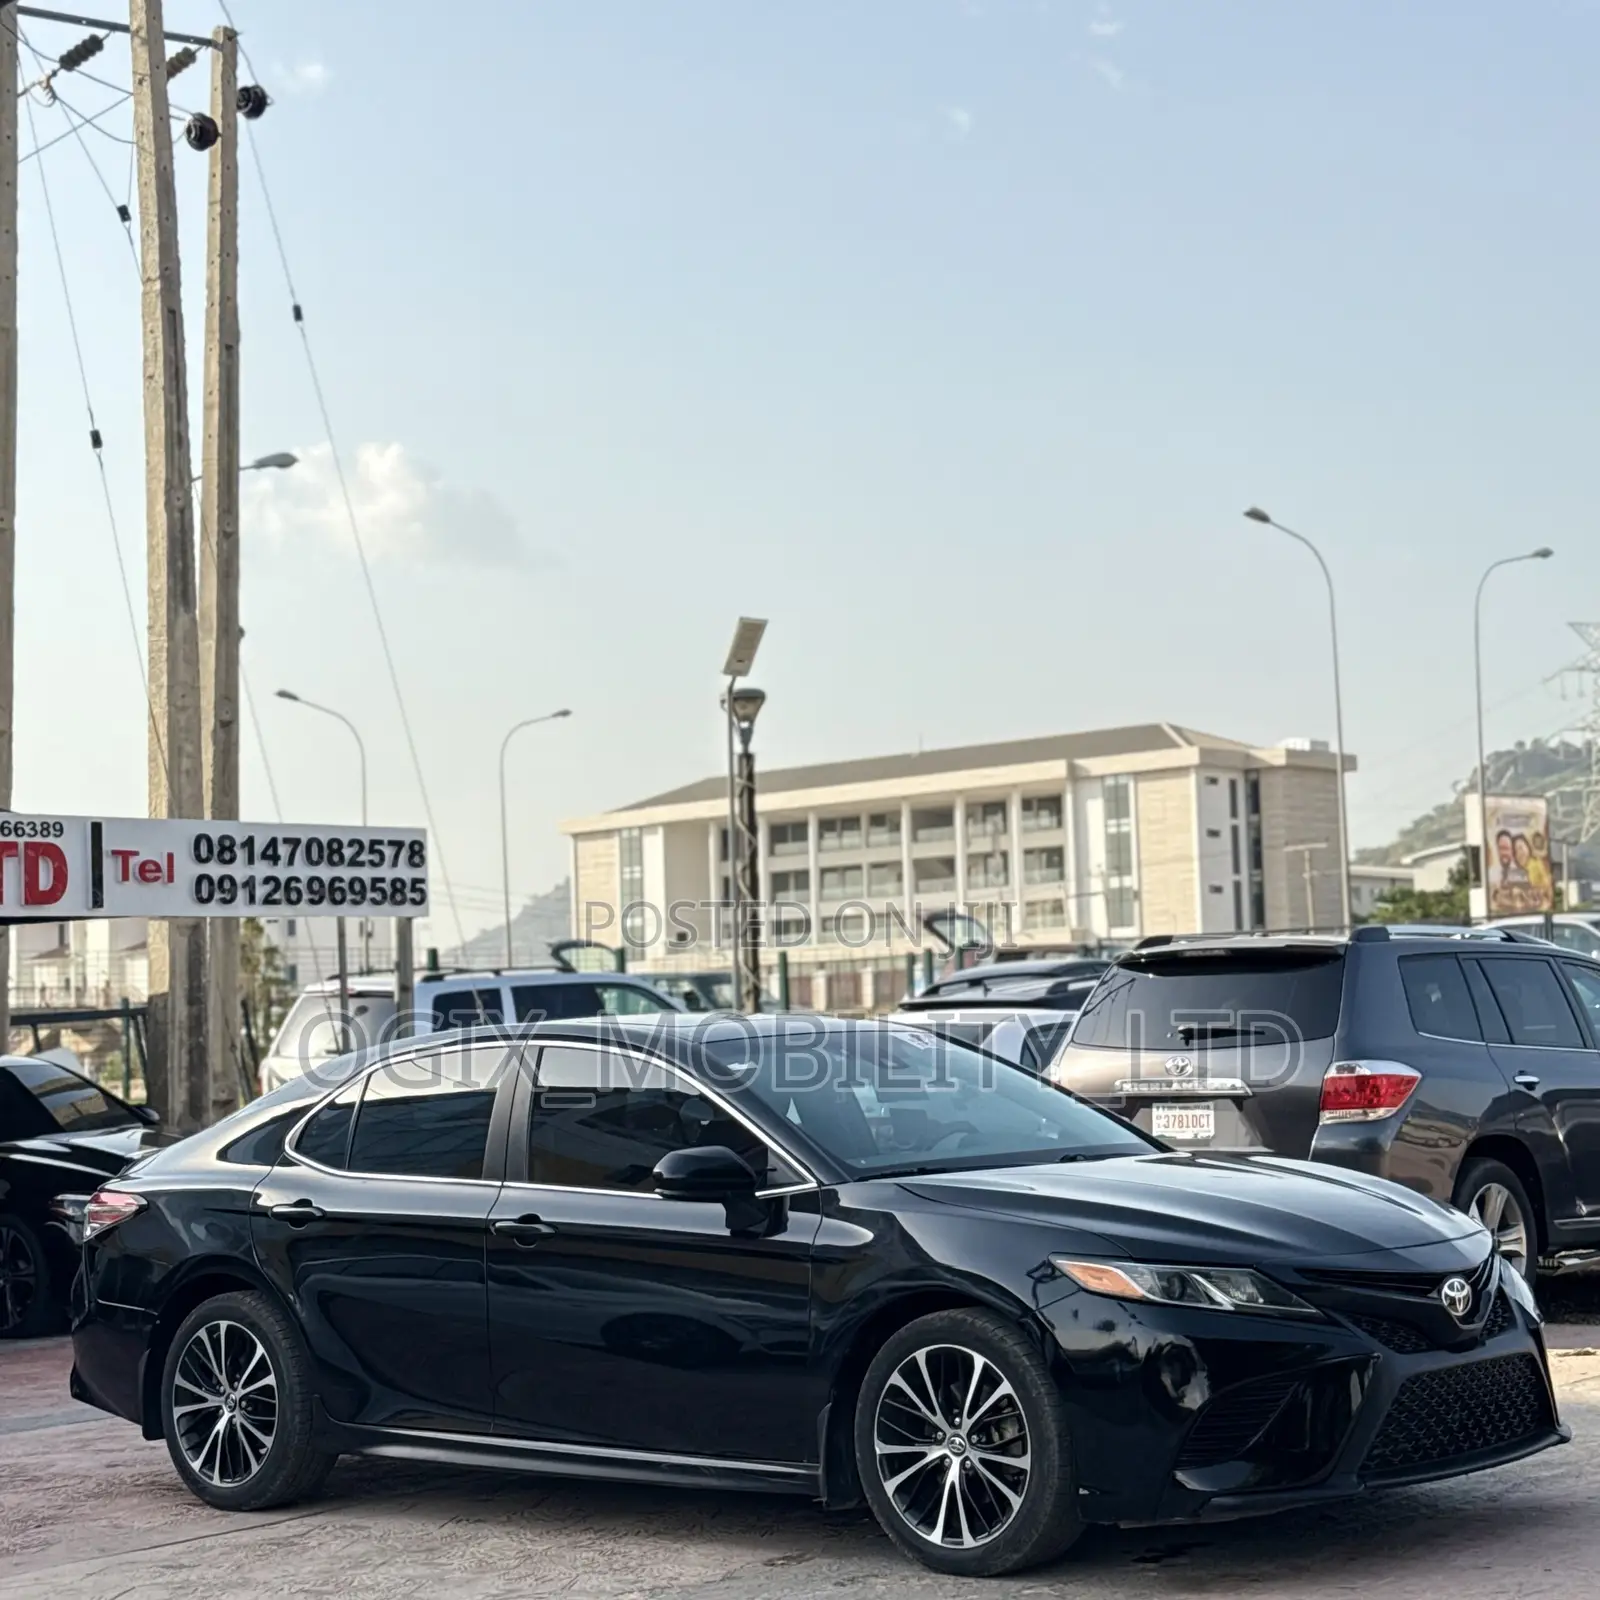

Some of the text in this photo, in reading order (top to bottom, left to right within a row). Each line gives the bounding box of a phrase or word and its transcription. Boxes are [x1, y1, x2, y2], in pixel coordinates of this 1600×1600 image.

[0, 820, 64, 838] 66389
[111, 849, 174, 884] Tel
[193, 833, 426, 869] 08147082578
[194, 873, 427, 907] 09126969585
